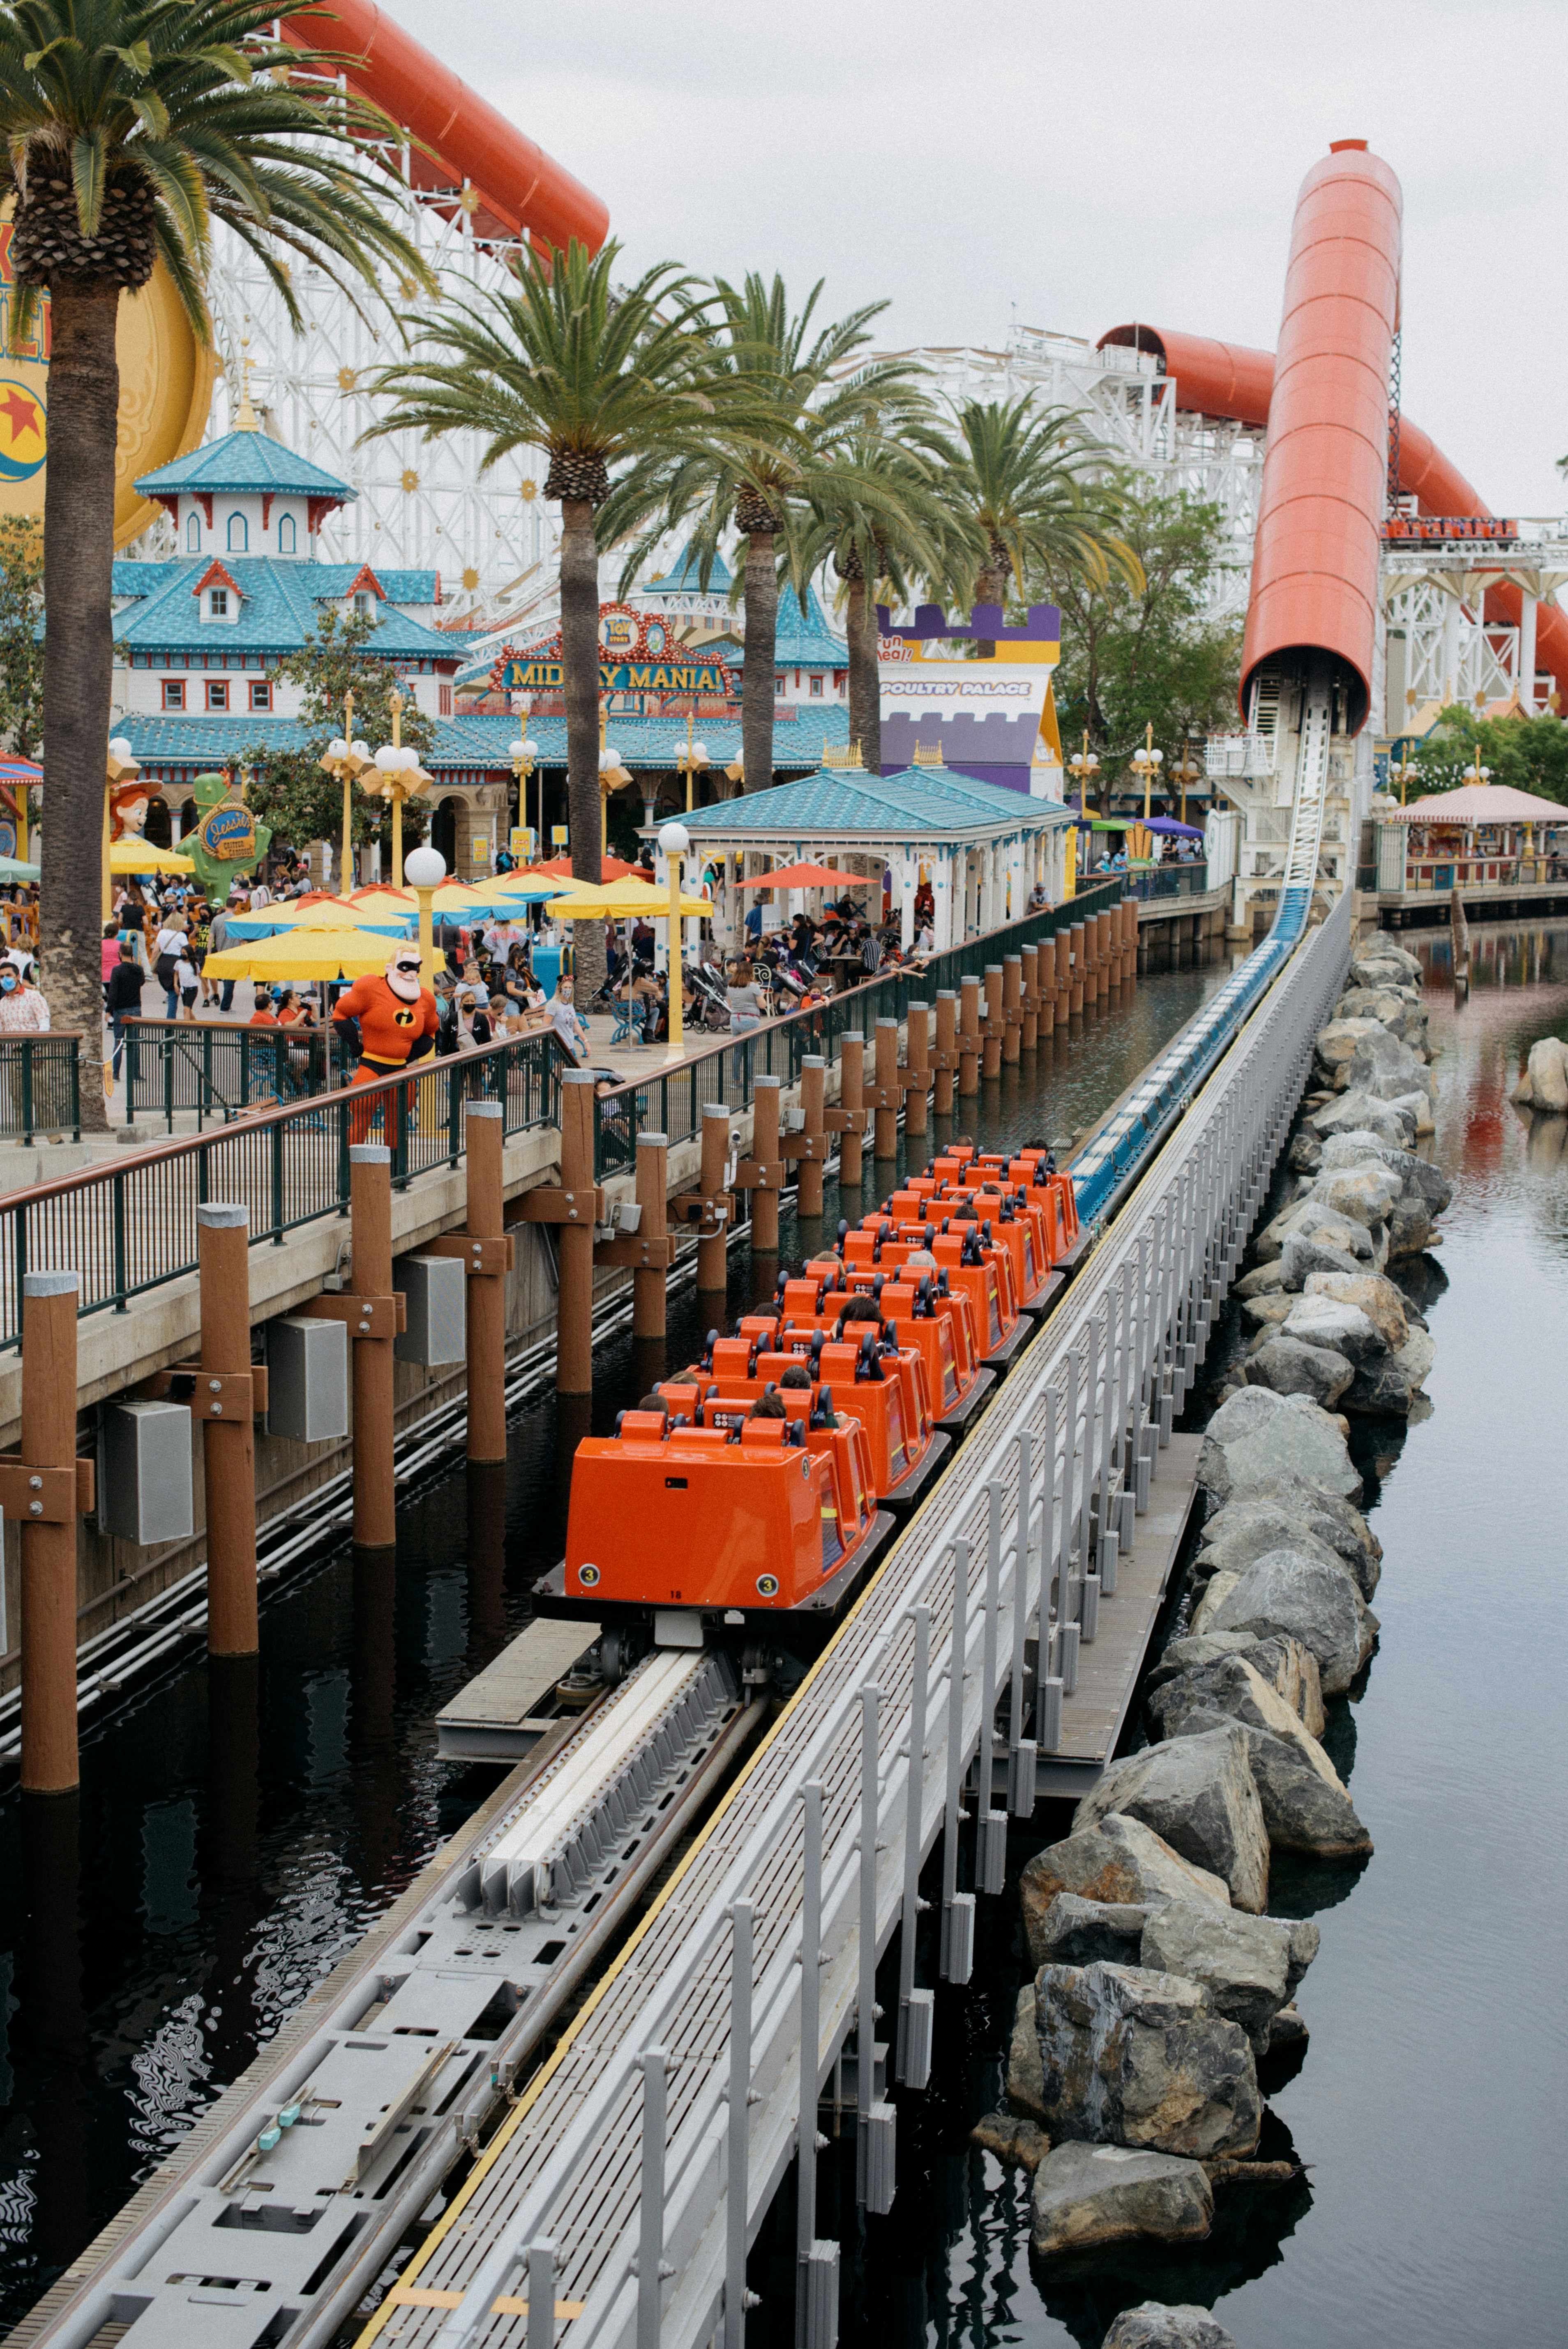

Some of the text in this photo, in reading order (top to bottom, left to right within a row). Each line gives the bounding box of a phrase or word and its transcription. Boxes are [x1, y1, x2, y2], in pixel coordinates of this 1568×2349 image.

[607, 620, 631, 635] TOY
[512, 663, 720, 690] MIDY MANIA!
[879, 682, 1031, 696] POULTRY PALACE
[210, 812, 251, 844] Jessie's
[224, 841, 244, 849] CRITTER
[229, 848, 253, 856] CAROUSEL
[803, 1461, 808, 1474] 3
[585, 1569, 594, 1581] 3
[763, 1580, 772, 1591] 3
[671, 1590, 681, 1599] 18
